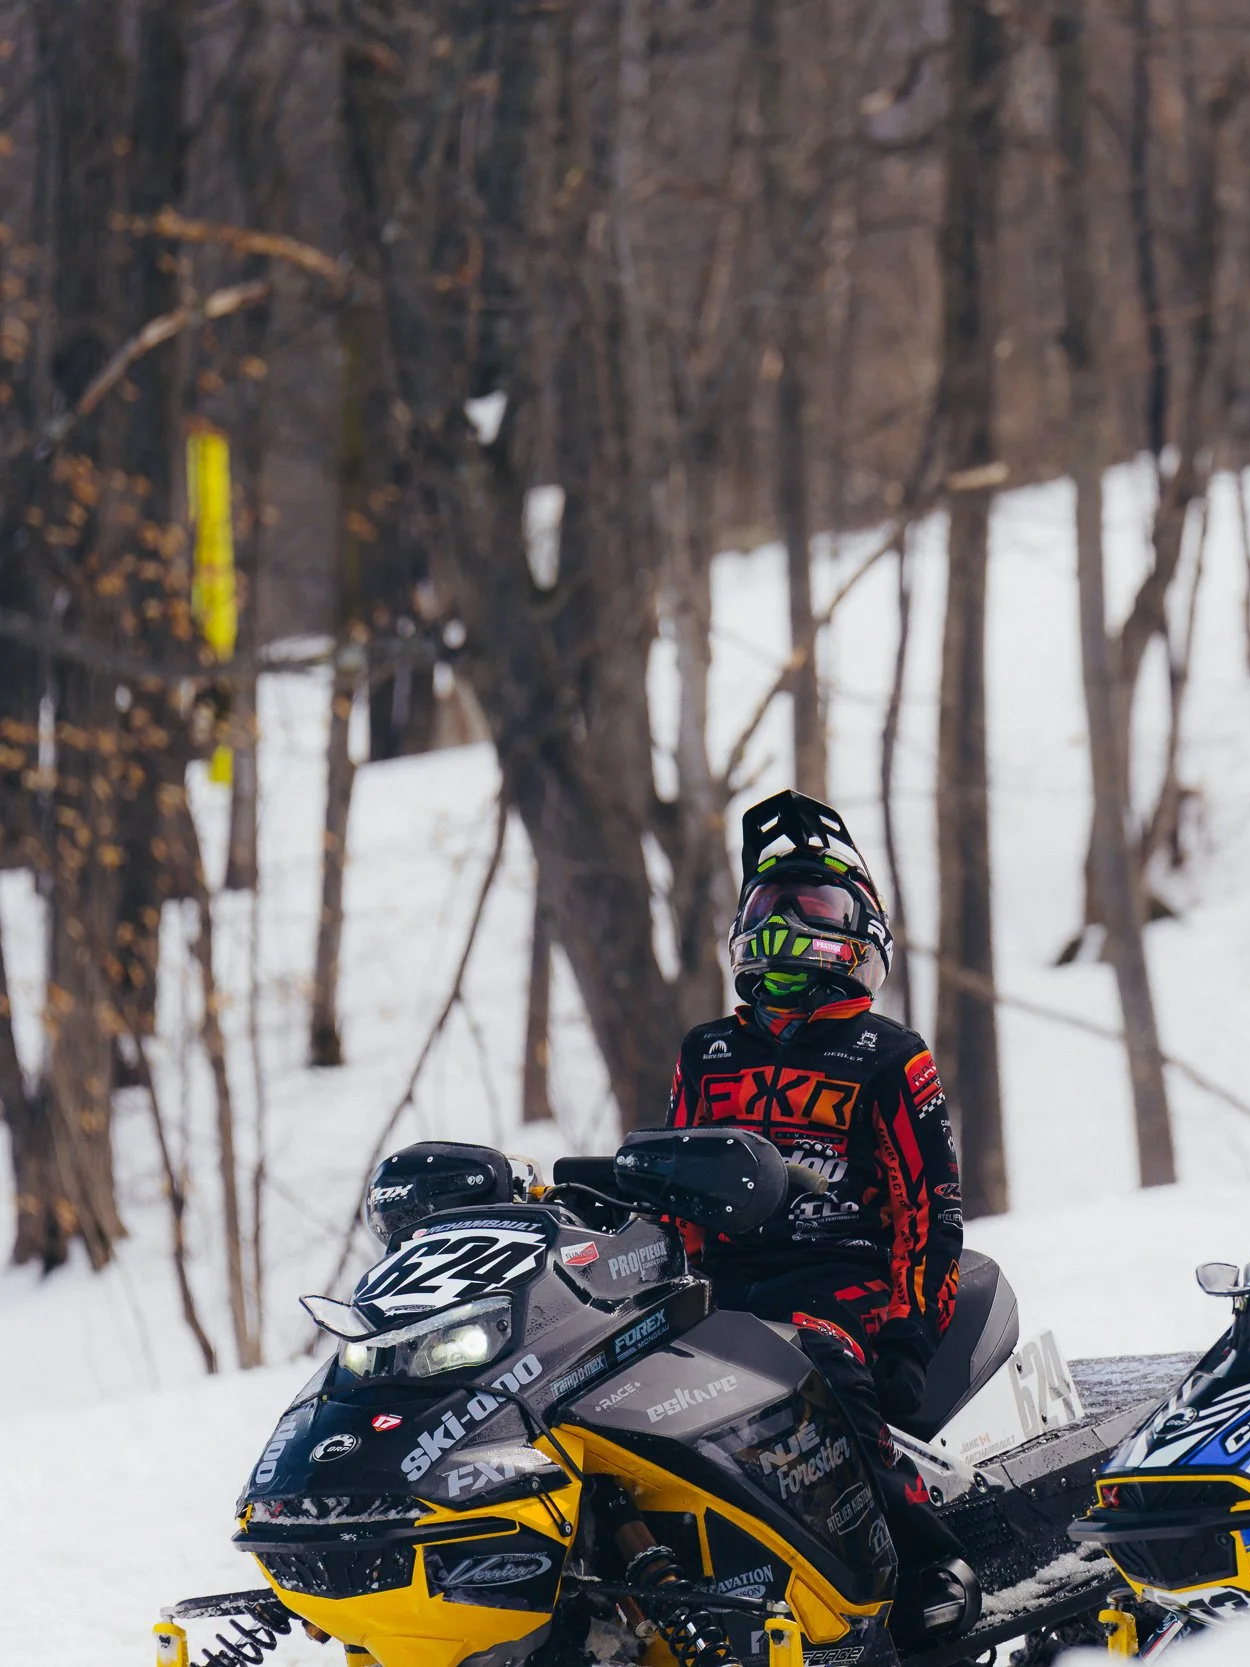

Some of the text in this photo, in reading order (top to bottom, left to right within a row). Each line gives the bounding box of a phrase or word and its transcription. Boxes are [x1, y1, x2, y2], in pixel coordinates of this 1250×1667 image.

[703, 1066, 861, 1131] FXR
[355, 1235, 547, 1304] 624
[608, 1251, 639, 1281] PRO
[615, 1308, 666, 1354] FOREX
[637, 1325, 669, 1350] MONGEAU
[1008, 1330, 1076, 1440] 624
[401, 1353, 543, 1482] ski-doo
[776, 1436, 850, 1500] Forestier
